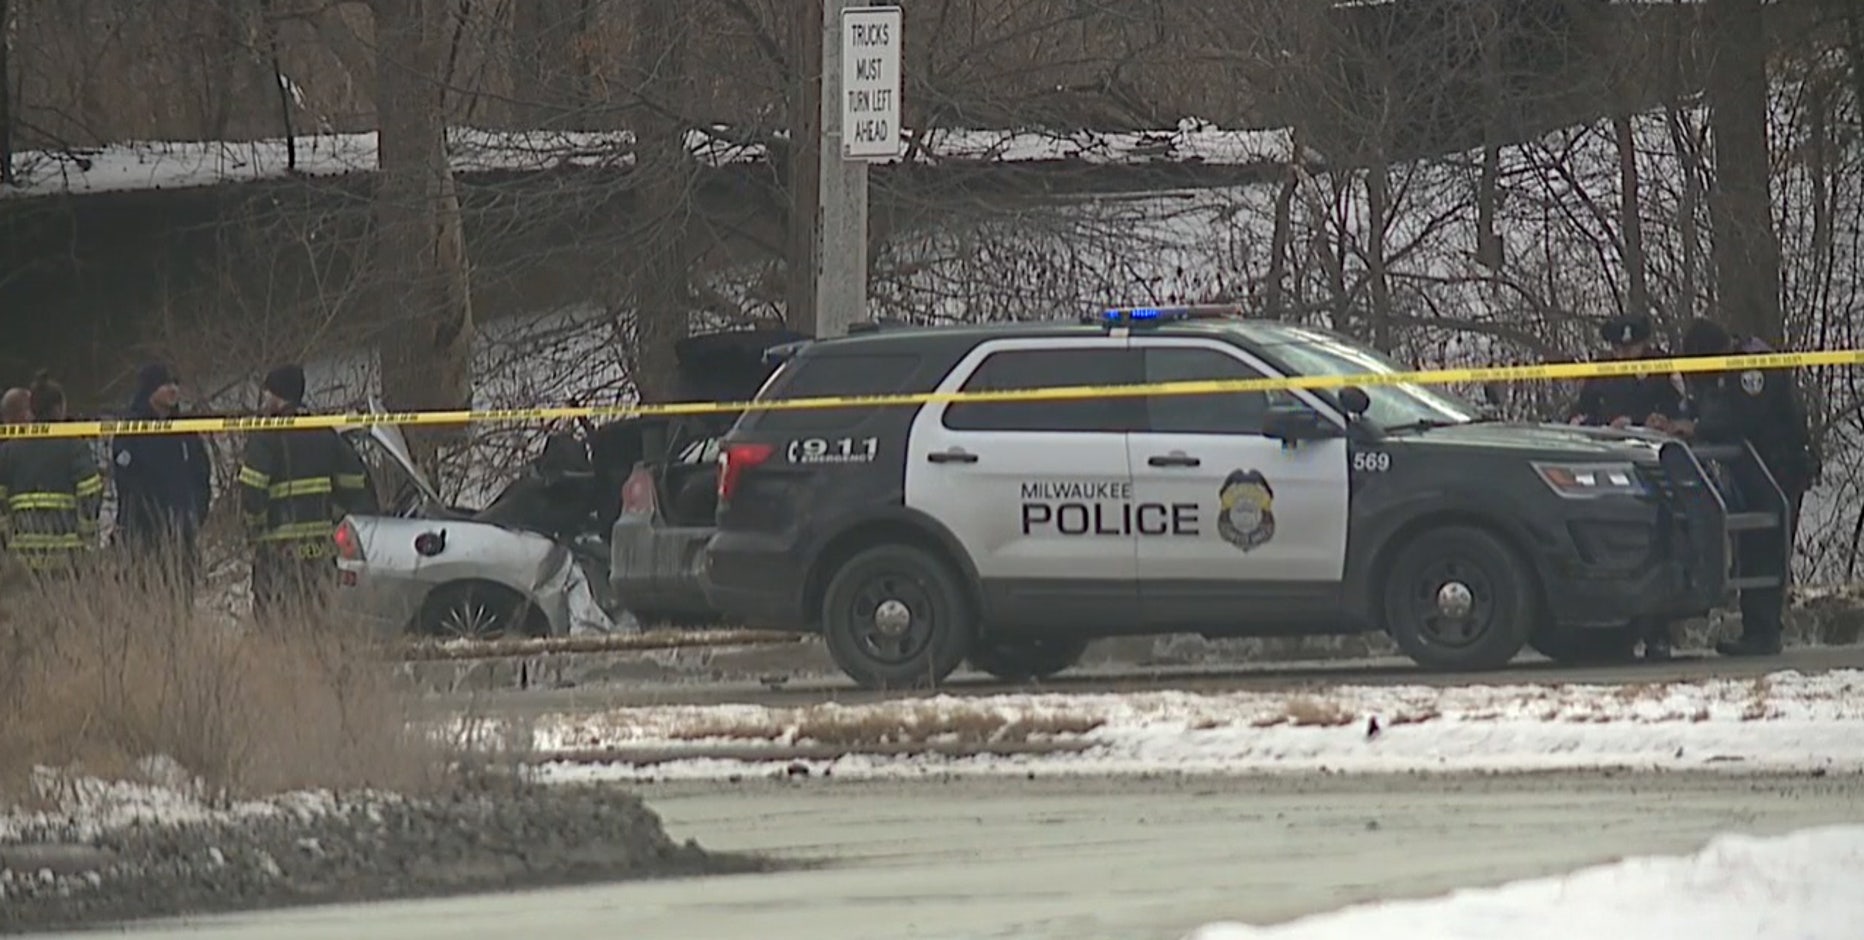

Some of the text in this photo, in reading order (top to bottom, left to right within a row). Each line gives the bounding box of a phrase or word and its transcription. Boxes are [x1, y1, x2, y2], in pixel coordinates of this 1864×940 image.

[851, 23, 889, 46] TRUCKS
[856, 58, 882, 80] MUST
[848, 89, 892, 112] TURN LEFT
[855, 120, 888, 142] AHEAD
[803, 437, 877, 458] 911
[1353, 452, 1390, 471] 569
[1020, 482, 1132, 499] MILWAUKEE
[1021, 502, 1200, 536] POLICE
